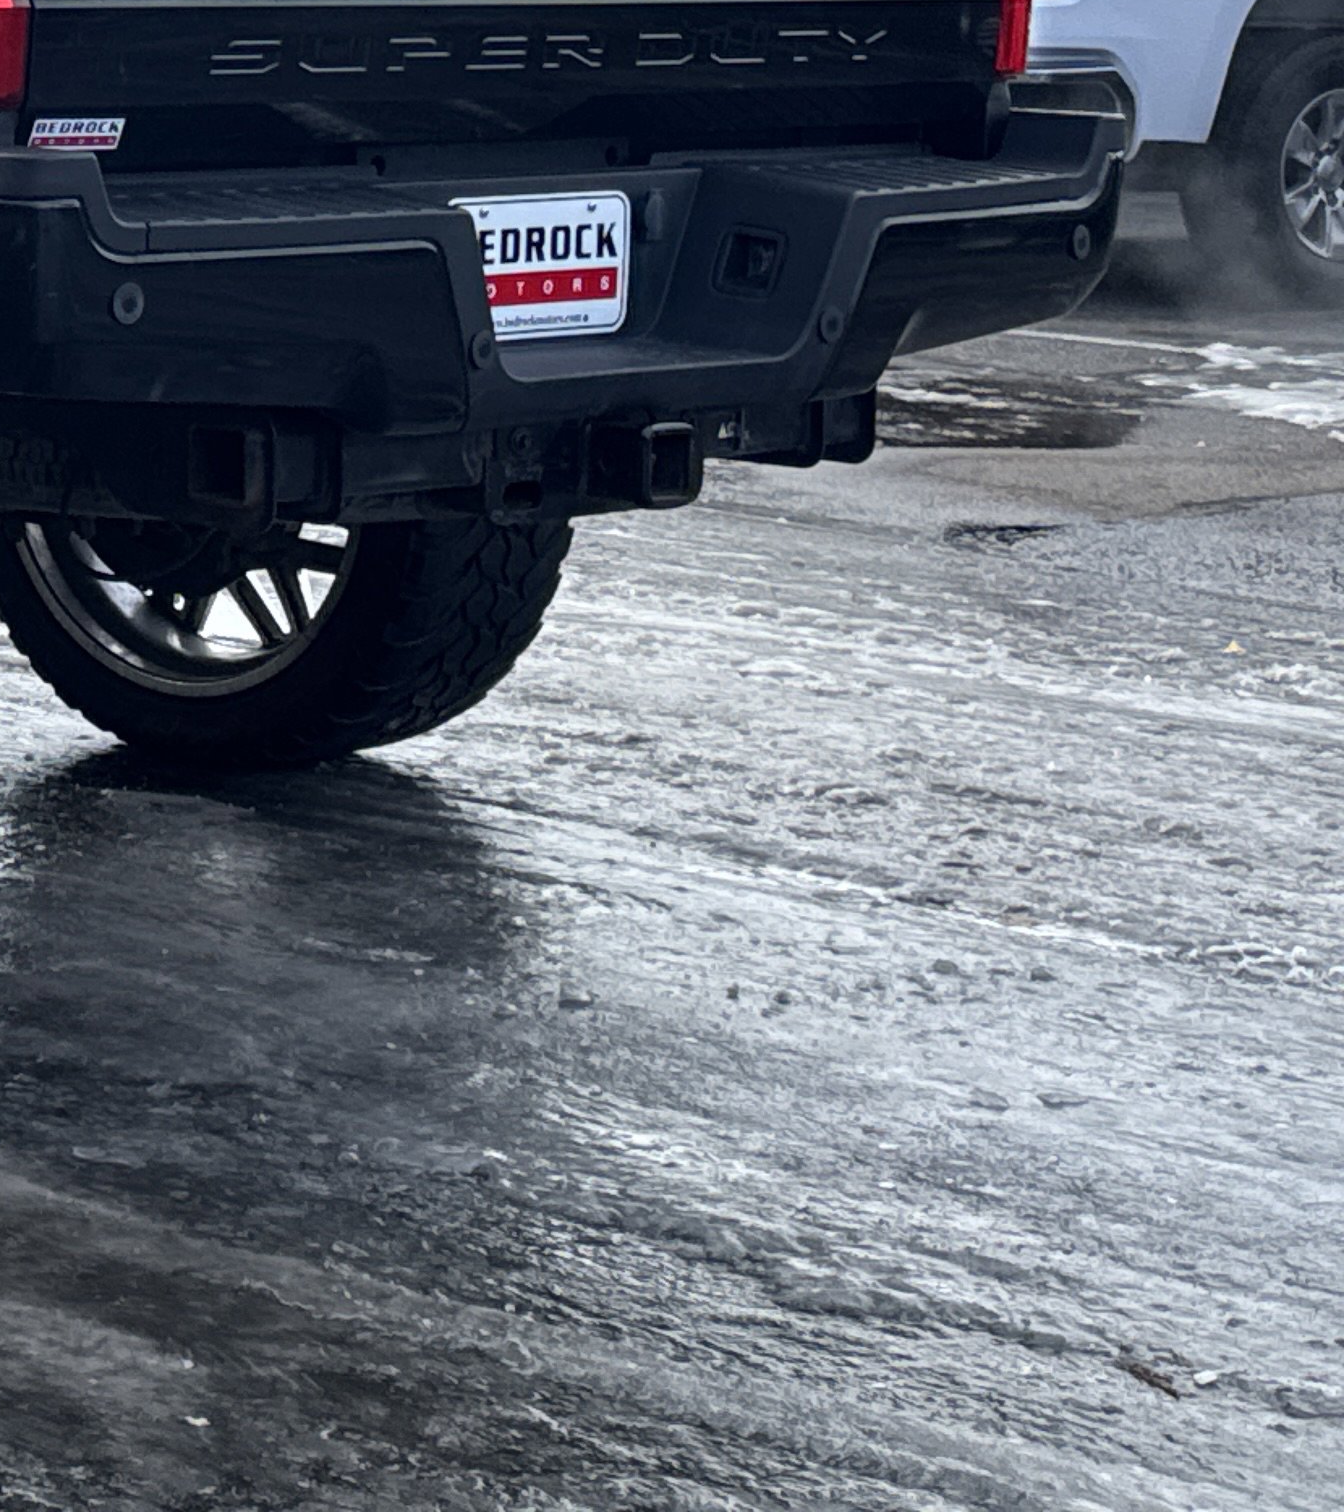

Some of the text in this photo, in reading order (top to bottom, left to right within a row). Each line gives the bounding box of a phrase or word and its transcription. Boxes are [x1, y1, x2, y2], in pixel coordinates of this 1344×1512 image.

[209, 29, 888, 76] SUPER DUTY
[34, 121, 119, 134] BEDROCK
[479, 222, 618, 265] EDROCK
[486, 275, 610, 299] OTORS
